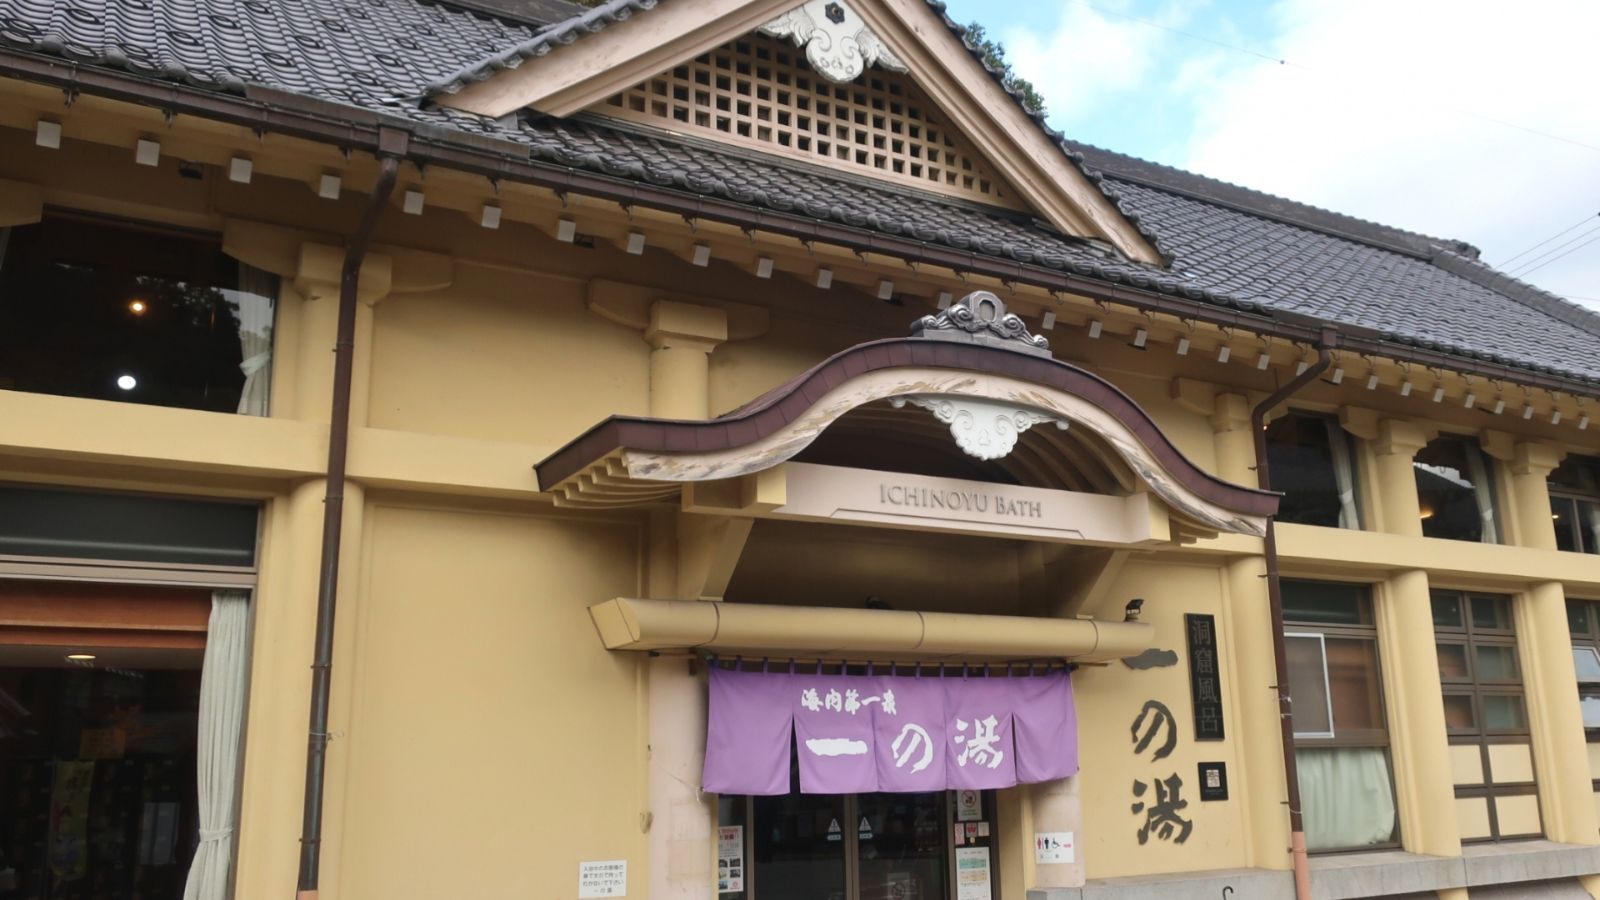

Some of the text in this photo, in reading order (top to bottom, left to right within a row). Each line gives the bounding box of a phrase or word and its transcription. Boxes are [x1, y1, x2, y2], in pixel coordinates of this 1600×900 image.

[879, 483, 1042, 518] ICHINOYU BATH
[1193, 619, 1219, 733] 洞窟風呂
[805, 714, 1004, 774] 一の湯
[1121, 648, 1193, 845] 一の湯
